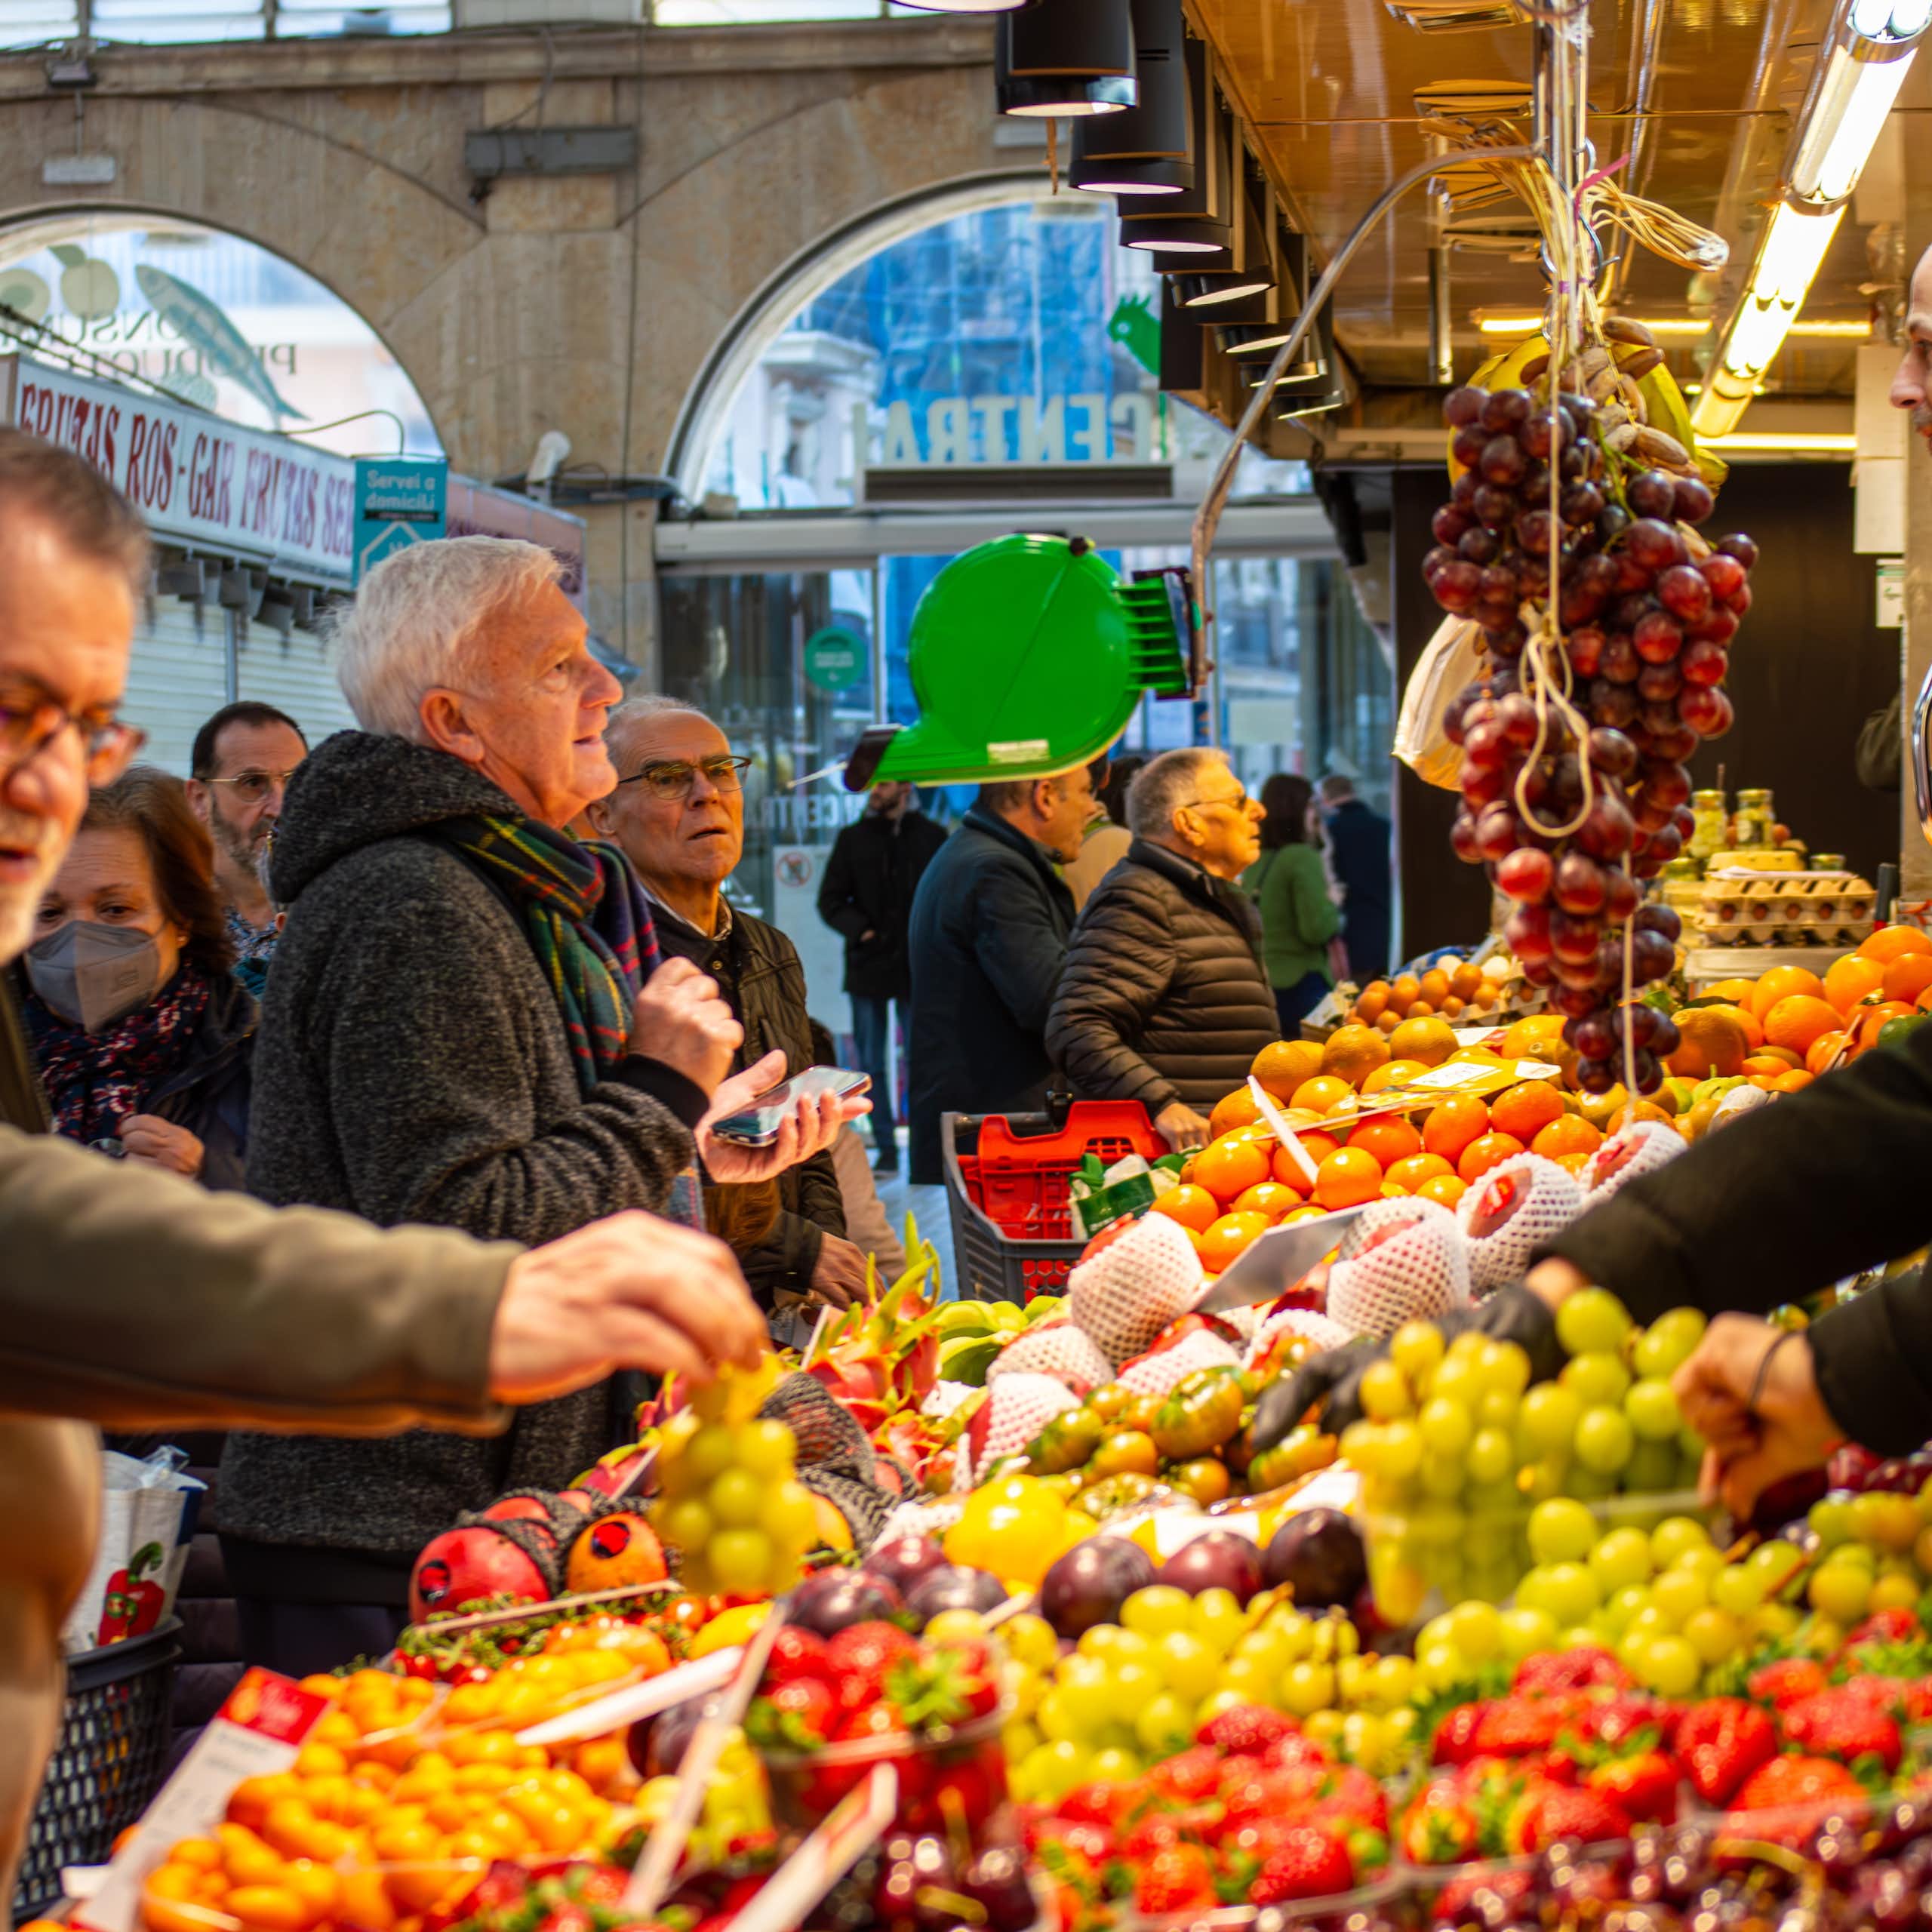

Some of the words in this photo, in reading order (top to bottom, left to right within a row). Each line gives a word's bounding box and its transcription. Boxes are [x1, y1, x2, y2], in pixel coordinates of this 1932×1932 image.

[238, 446, 319, 549] FRUTAS
[366, 469, 420, 490] Servei
[425, 477, 435, 491] a
